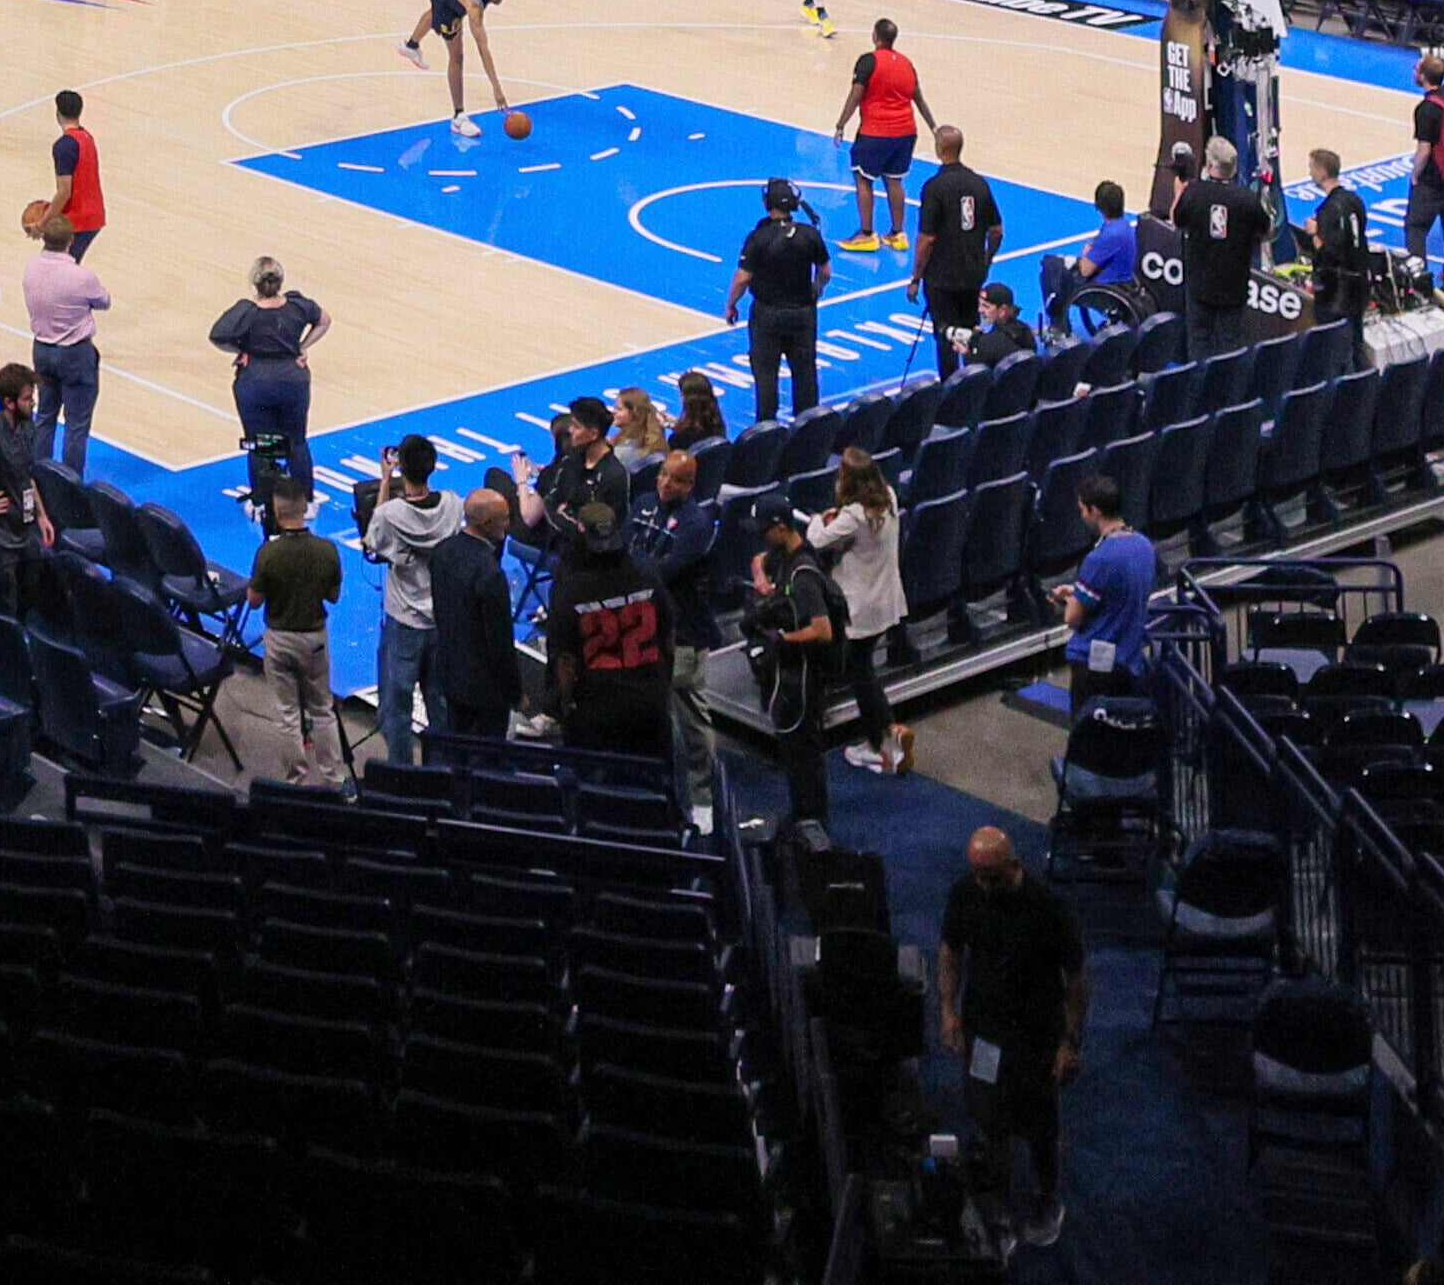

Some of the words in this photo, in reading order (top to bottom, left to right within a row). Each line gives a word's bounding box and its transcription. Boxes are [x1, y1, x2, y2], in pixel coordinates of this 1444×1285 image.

[1167, 40, 1191, 67] GET
[1168, 66, 1192, 91] THE
[1173, 90, 1198, 123] App
[578, 600, 661, 672] 22
